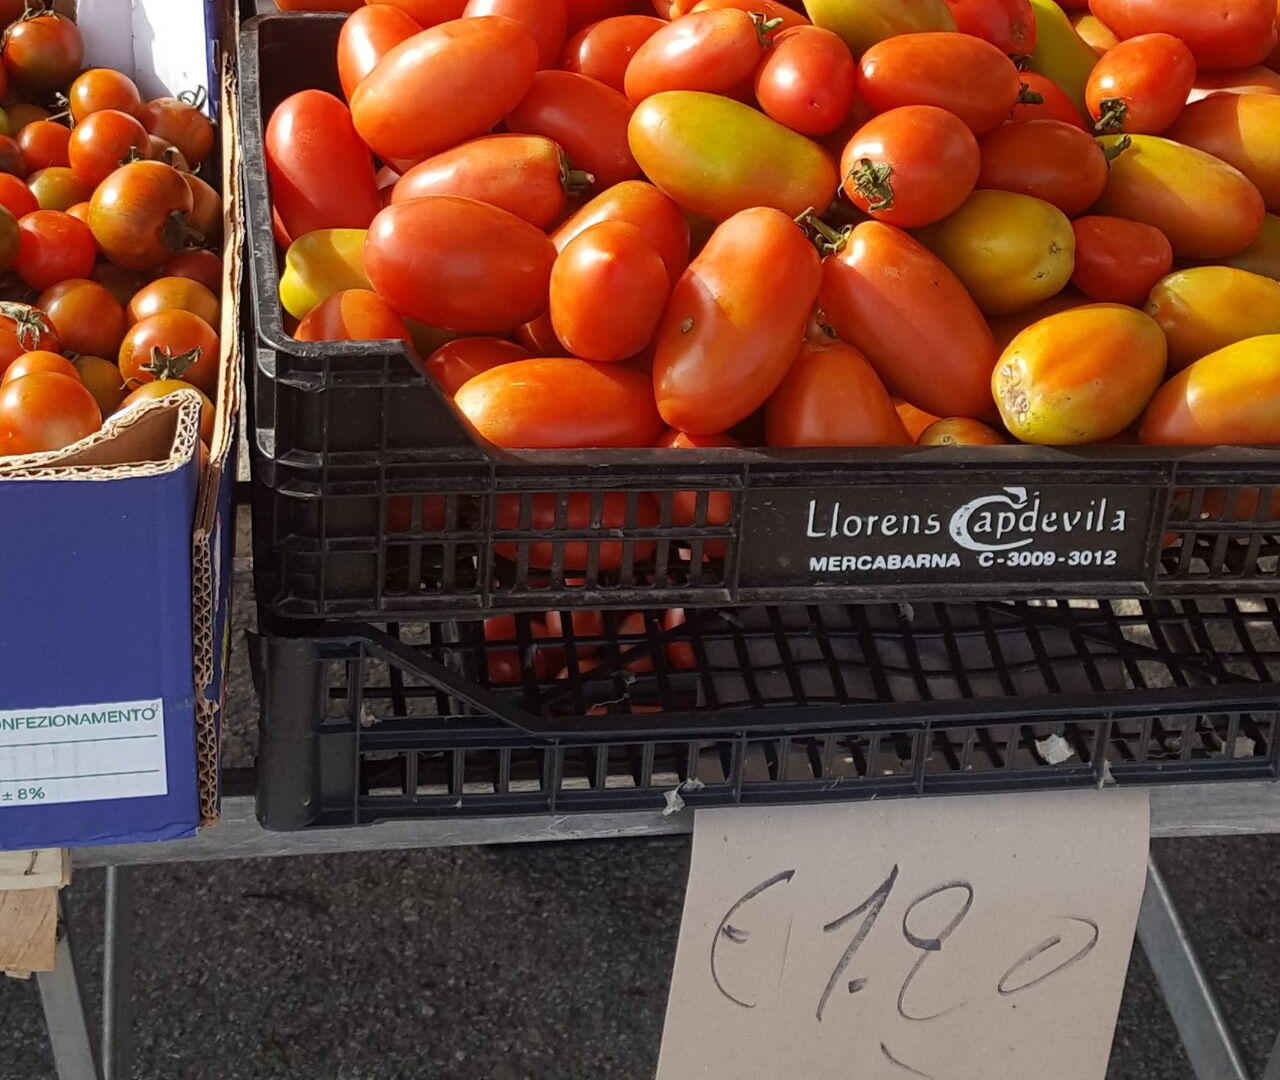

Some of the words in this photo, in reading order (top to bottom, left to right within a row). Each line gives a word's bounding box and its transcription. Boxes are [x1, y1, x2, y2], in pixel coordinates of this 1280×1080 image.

[806, 499, 941, 539] Llorens
[809, 554, 961, 572] MERCABARNA
[2, 791, 14, 801] ±
[17, 787, 46, 800] 8%
